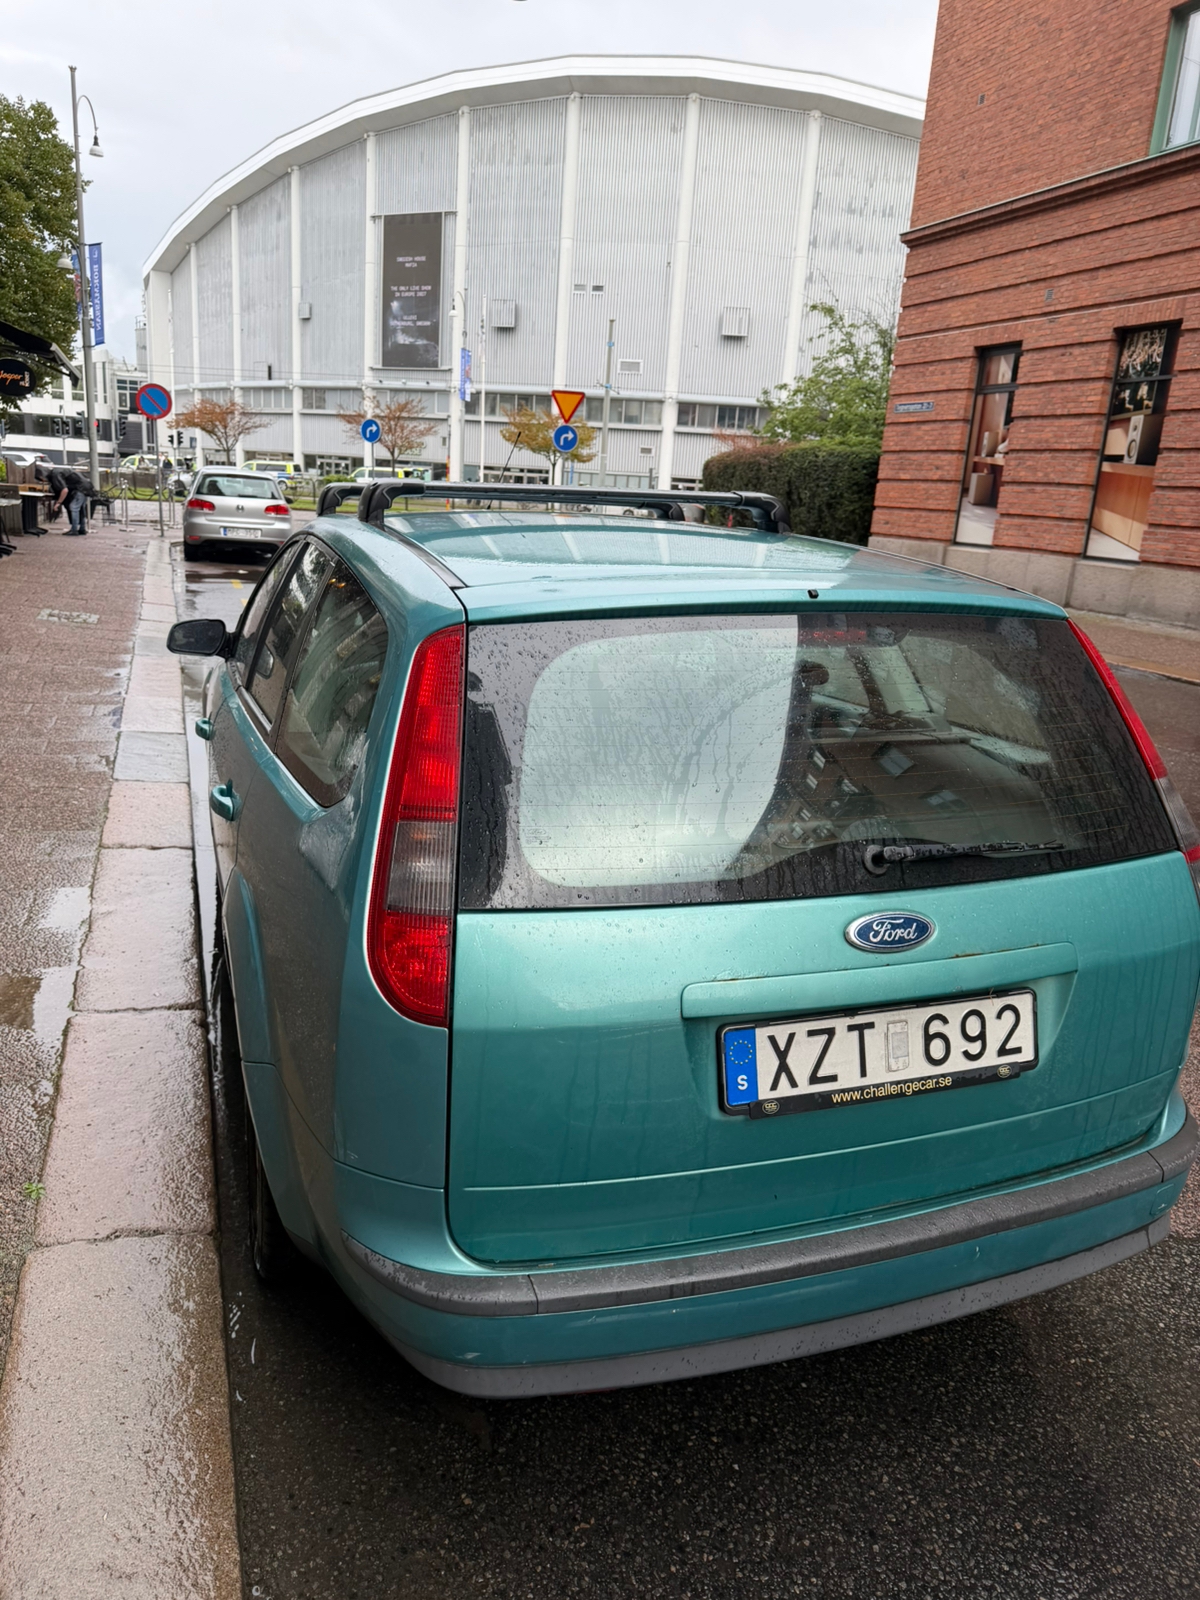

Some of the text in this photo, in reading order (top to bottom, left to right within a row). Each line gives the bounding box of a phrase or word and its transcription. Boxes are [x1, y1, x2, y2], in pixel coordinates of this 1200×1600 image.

[869, 919, 918, 943] Ford
[737, 1075, 748, 1091] S
[831, 1075, 953, 1103] www.challengecar.se
